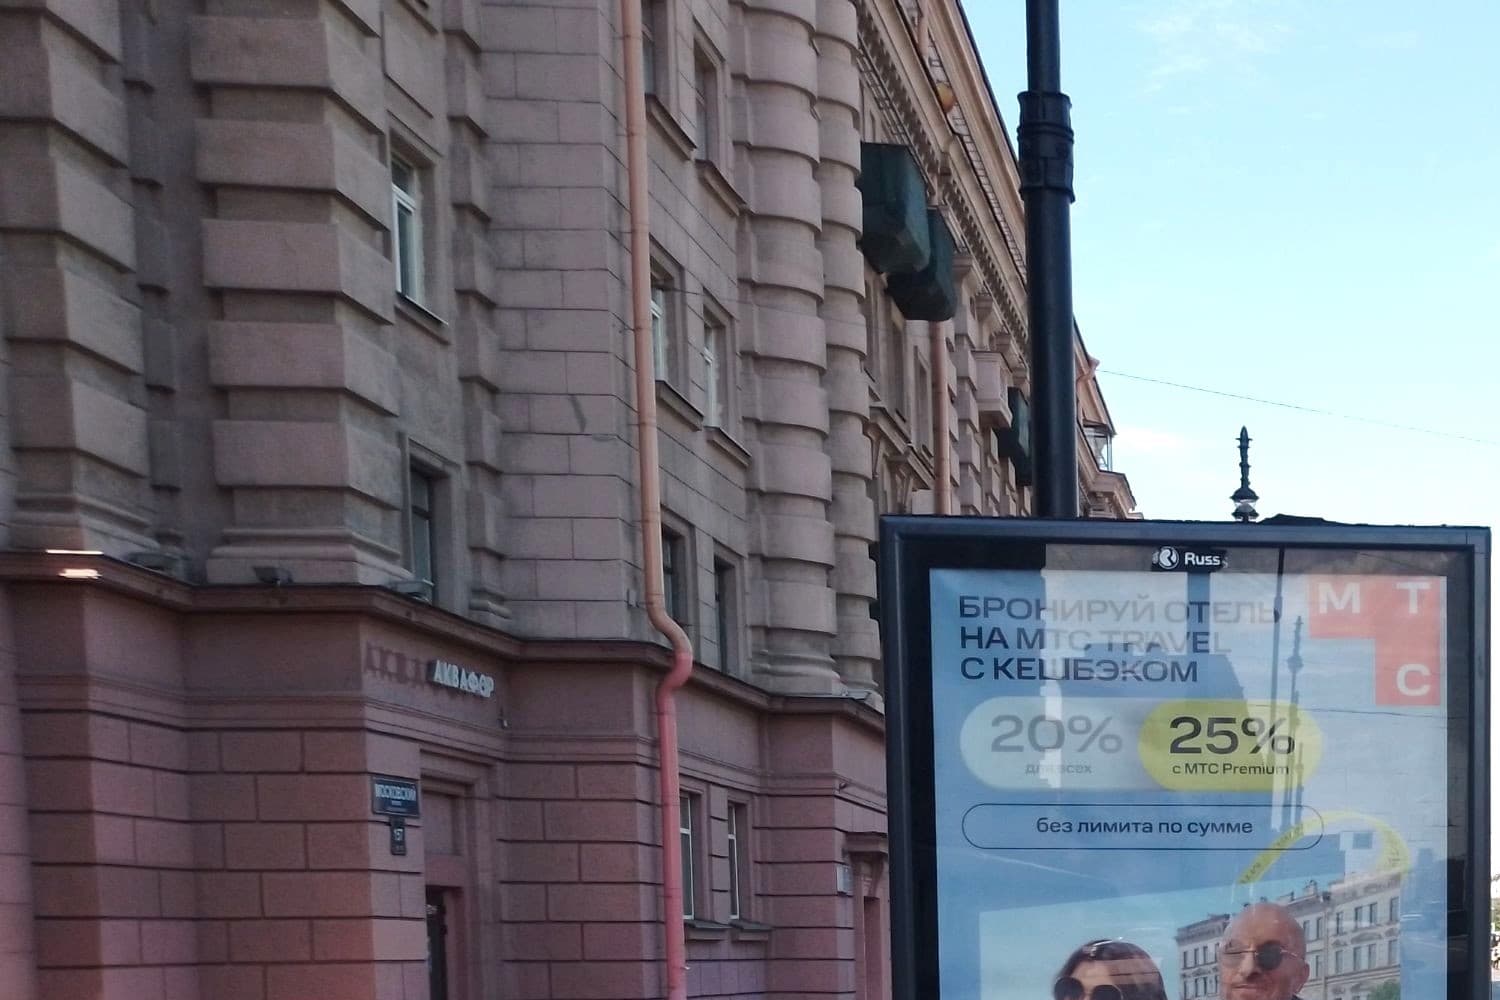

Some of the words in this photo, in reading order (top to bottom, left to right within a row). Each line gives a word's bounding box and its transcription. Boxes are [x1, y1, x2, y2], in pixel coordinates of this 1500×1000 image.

[1184, 552, 1221, 566] Russ
[959, 593, 1153, 623] БРОНИРУЙ
[1163, 600, 1280, 624] ОТЕЛЬ
[960, 626, 1009, 650] НА
[1016, 628, 1092, 652] МТС
[1098, 630, 1232, 654] TRAVEL
[961, 657, 984, 680] С
[993, 657, 1199, 683] КЕШБЭКОМ
[991, 714, 1123, 754] 20%
[1169, 716, 1296, 755] 25%
[1172, 765, 1181, 775] с
[1185, 762, 1219, 775] МТС
[1222, 763, 1290, 776] Premium
[1036, 817, 1073, 834] без
[1077, 820, 1153, 834] лимита
[1158, 822, 1183, 835] по
[1187, 821, 1253, 838] сумме
